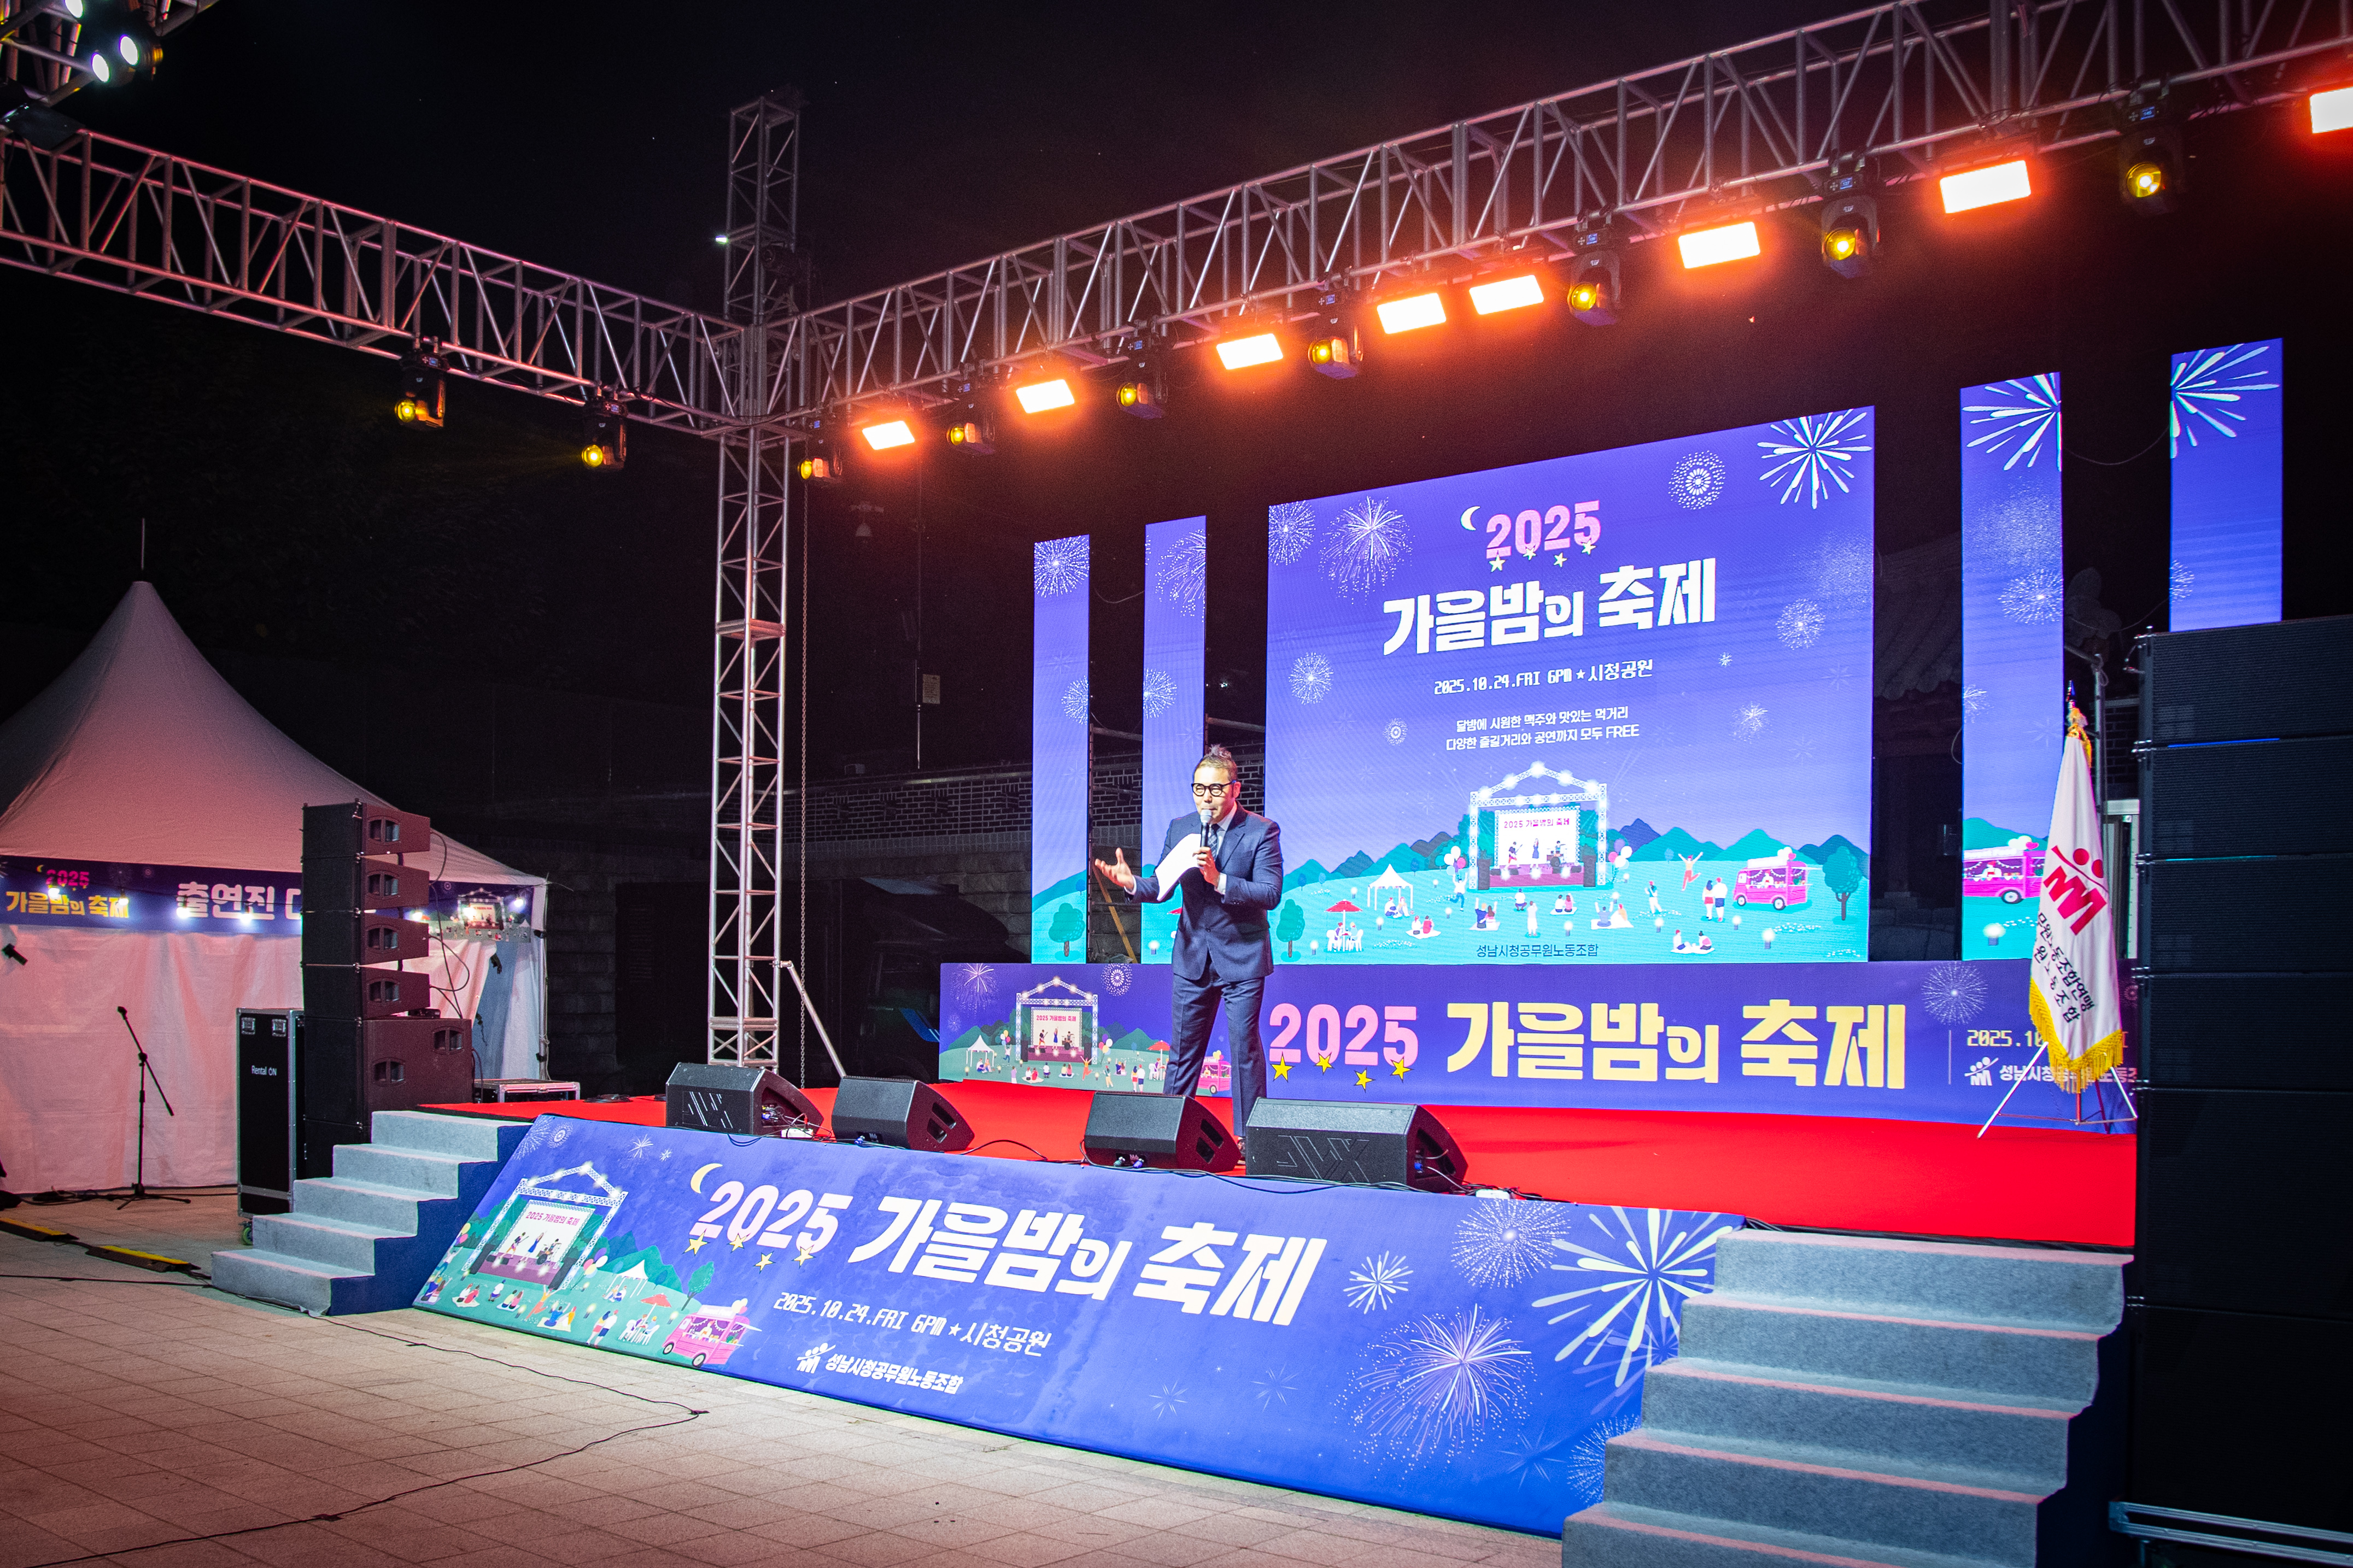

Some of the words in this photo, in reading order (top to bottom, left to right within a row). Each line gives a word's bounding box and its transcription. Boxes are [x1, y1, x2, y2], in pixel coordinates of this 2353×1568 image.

[1486, 500, 1601, 559] 2025
[1383, 580, 1584, 656] 가을밤의
[1597, 557, 1717, 631] 축제
[1434, 671, 1541, 695] 2025.10.24.FRI
[1547, 668, 1572, 684] 6PM
[1588, 659, 1653, 683] 시청공원
[1456, 718, 1487, 732] 달밤에
[1490, 715, 1521, 730] 시원한
[1524, 712, 1556, 726] 맥주와
[1559, 709, 1592, 724] 맛있는
[1595, 706, 1629, 721] 먹거리
[1446, 736, 1477, 751] 다양한
[1479, 732, 1531, 749] 즐길거리와
[1534, 729, 1578, 744] 공연까지
[1580, 727, 1603, 740] 모두
[1606, 724, 1640, 739] FREE
[1504, 820, 1523, 829] 2025
[46, 870, 89, 886] 2025
[6, 891, 85, 916] 가을밤의
[89, 895, 130, 918] 축제
[176, 881, 276, 921] 출연진
[1477, 944, 1599, 957] 성남시청공무원노동조합
[1269, 1002, 1419, 1065] 2025
[1447, 1002, 1719, 1083] 가을밤의
[1741, 999, 1906, 1089] 축제
[251, 1065, 267, 1076] Rental
[526, 1212, 544, 1220] 2025
[689, 1181, 853, 1254] 2025
[848, 1196, 1133, 1301] 가을밤의
[1133, 1221, 1327, 1326] 축제
[774, 1292, 909, 1330] 2025.10.24.FRI
[911, 1314, 947, 1336] 6PM
[959, 1322, 1052, 1356] 시청공원
[825, 1353, 964, 1394] 성남시청공무원노동조합
